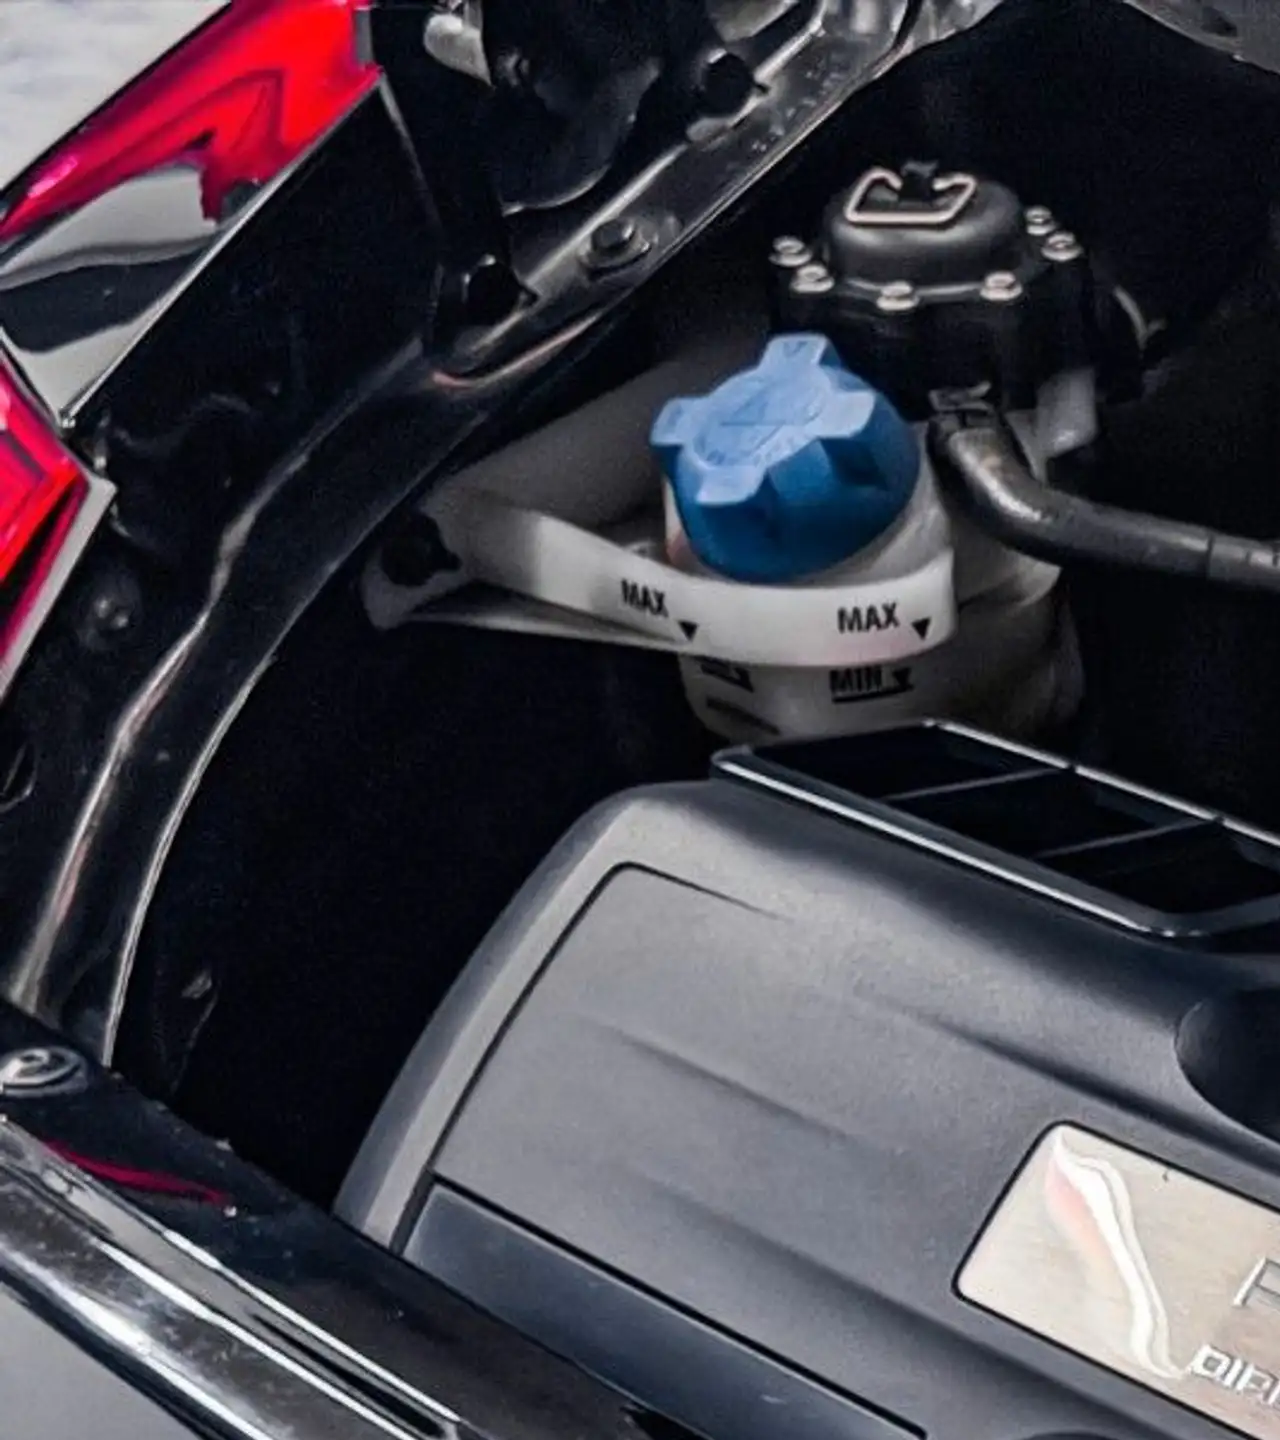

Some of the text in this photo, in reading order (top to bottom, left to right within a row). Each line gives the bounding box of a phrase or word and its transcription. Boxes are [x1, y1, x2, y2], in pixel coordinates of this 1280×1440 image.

[621, 578, 670, 618] MAX
[837, 602, 899, 634] MAX
[829, 667, 884, 694] MIN
